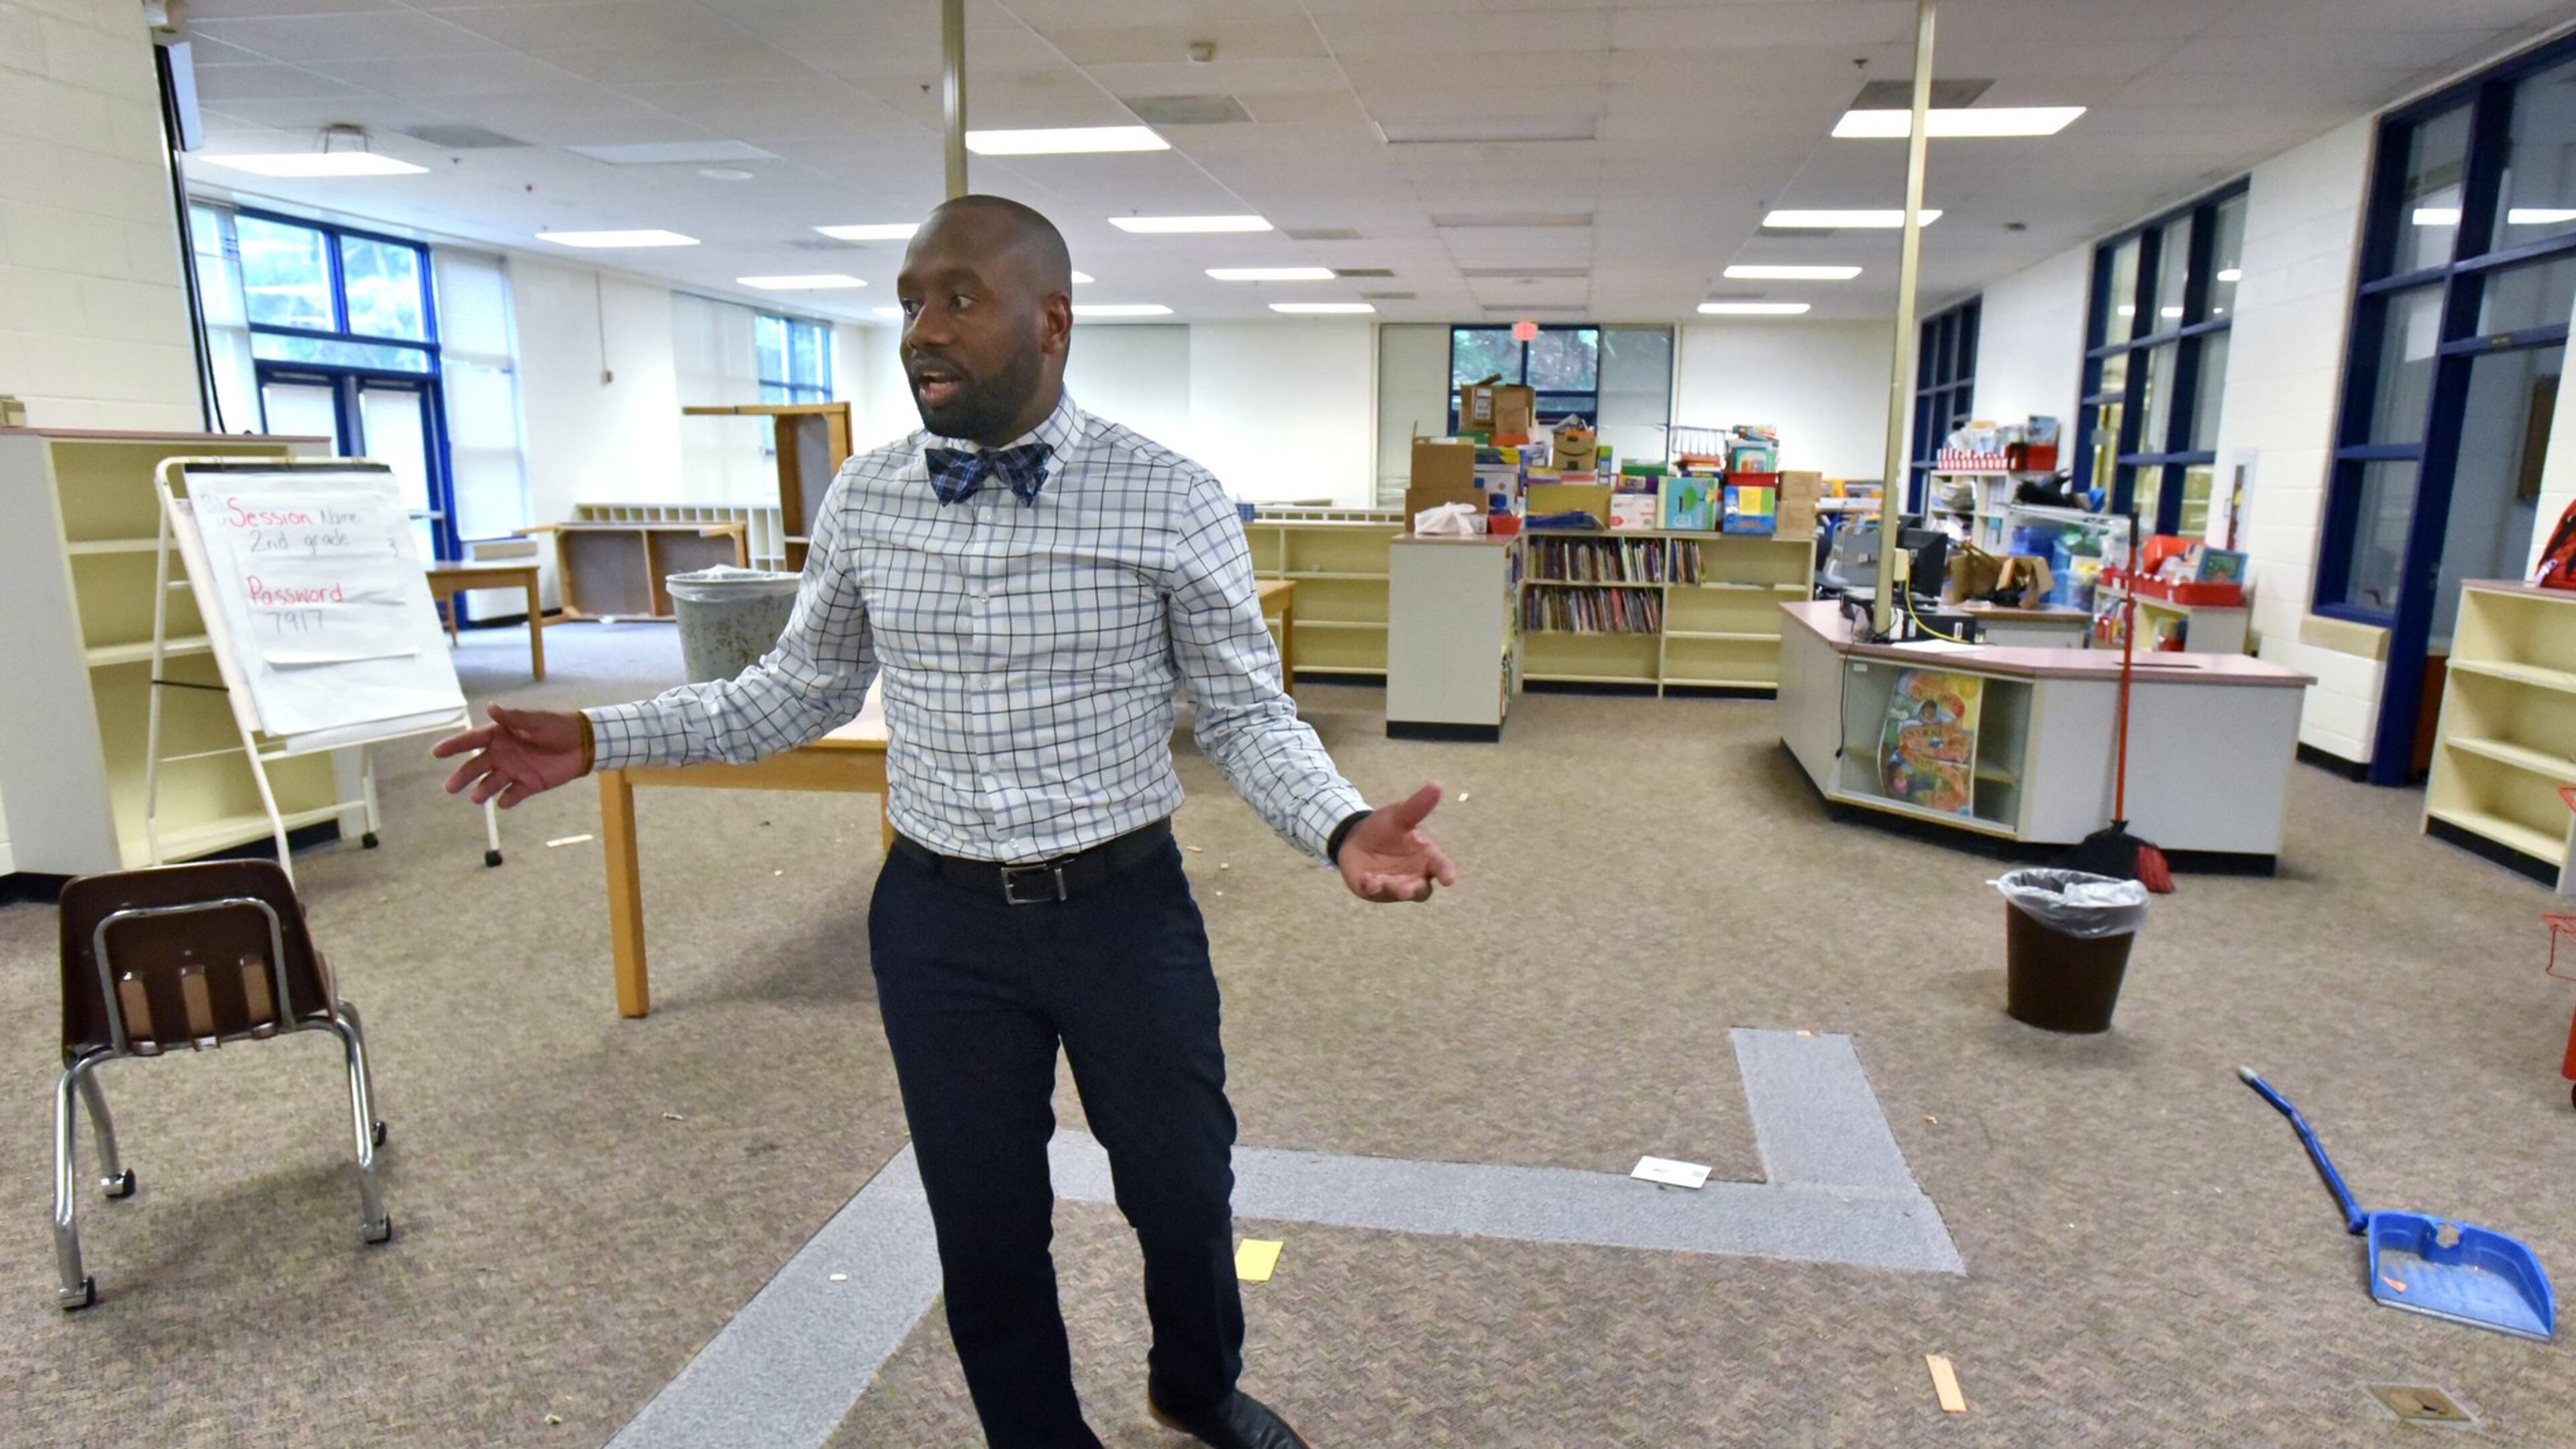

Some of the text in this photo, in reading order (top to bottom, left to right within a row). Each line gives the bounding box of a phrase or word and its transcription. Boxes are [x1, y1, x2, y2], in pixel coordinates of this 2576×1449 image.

[227, 496, 360, 527] Session Name
[250, 529, 351, 555] 2nd grade
[247, 575, 343, 606] Password
[266, 608, 323, 634] 7917
